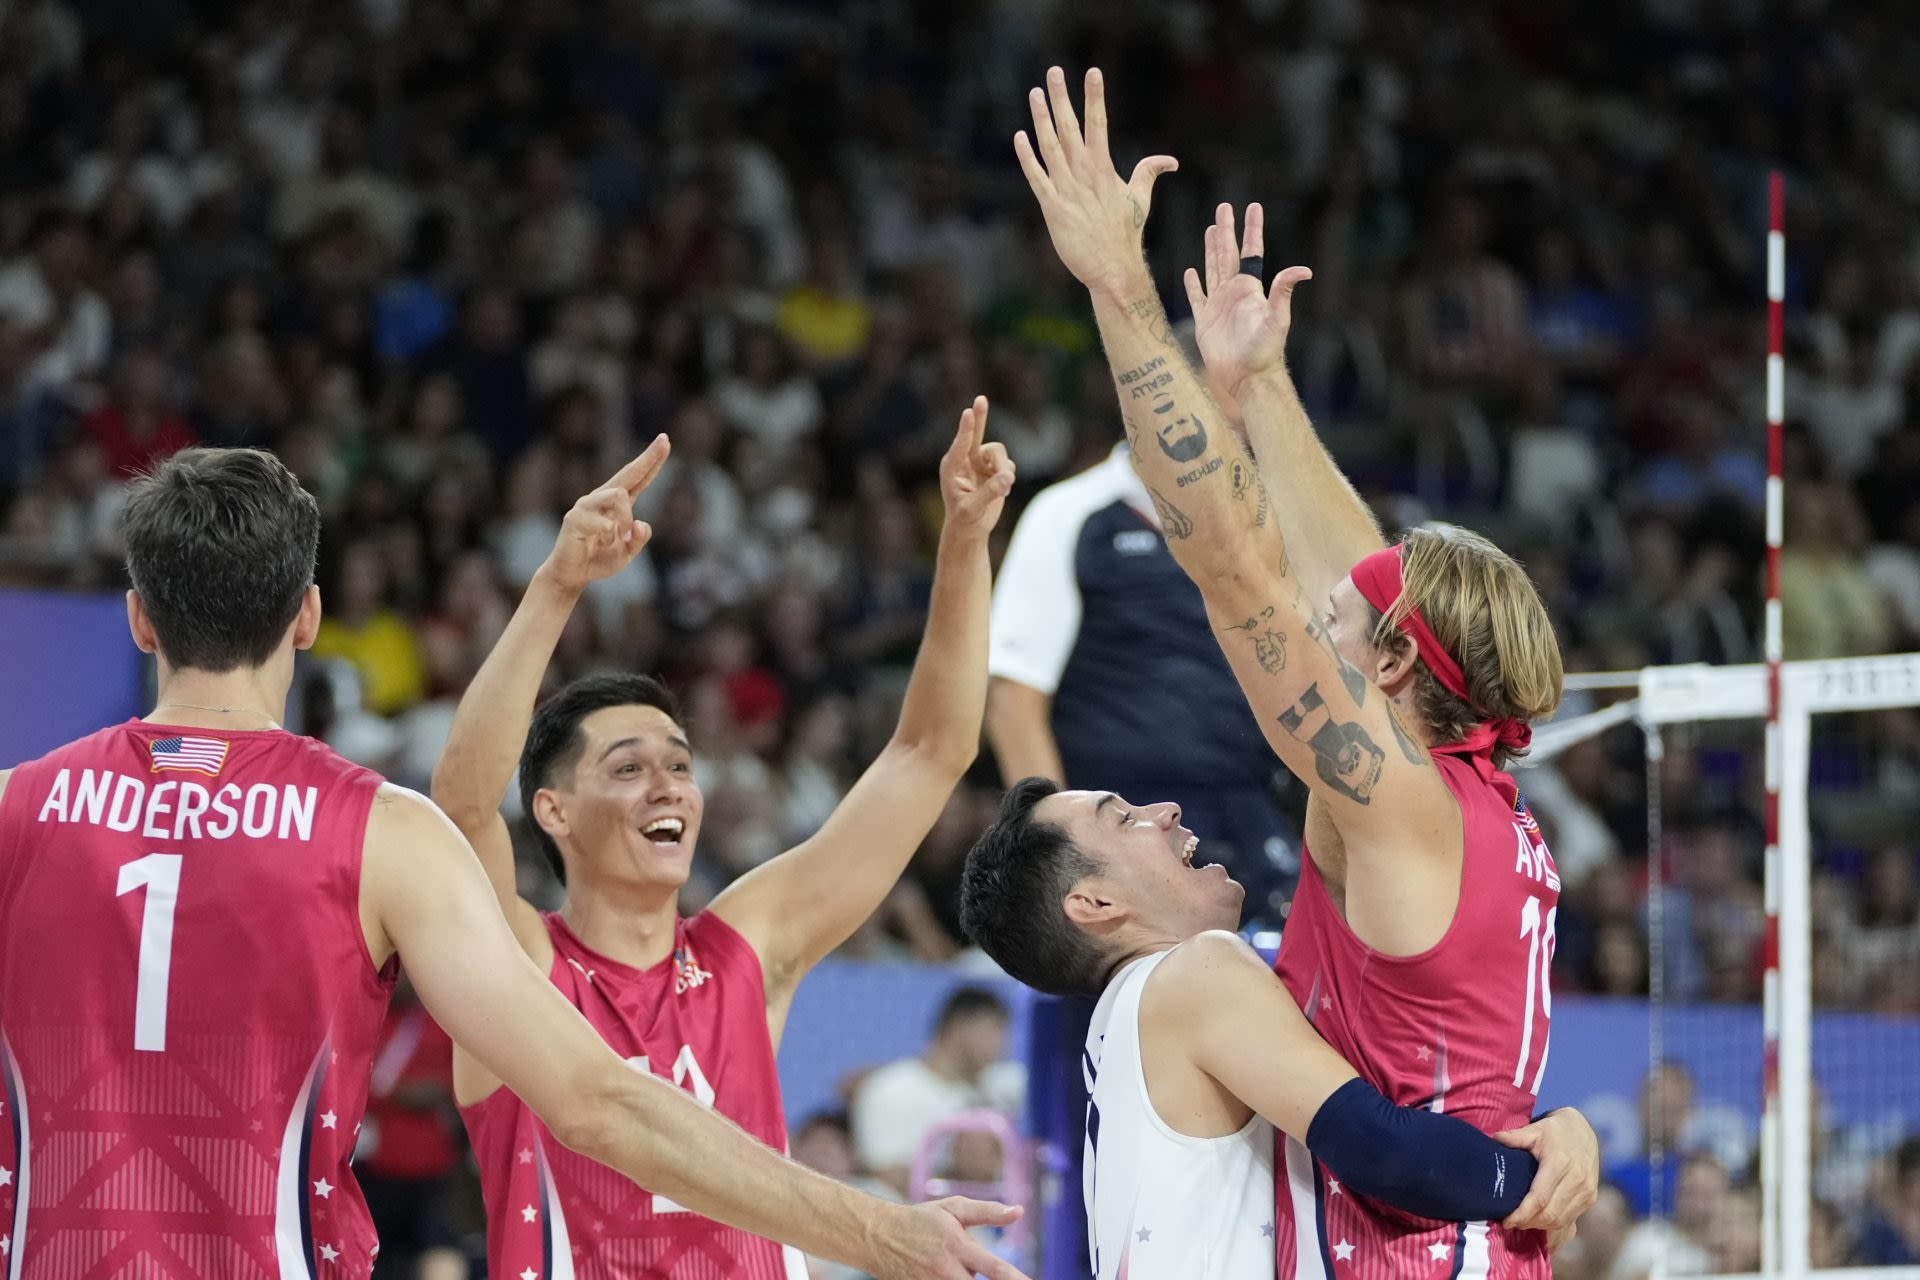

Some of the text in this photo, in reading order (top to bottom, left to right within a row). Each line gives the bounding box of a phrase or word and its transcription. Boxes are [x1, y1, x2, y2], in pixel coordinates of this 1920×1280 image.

[1118, 355, 1167, 386] MATTERS
[1131, 371, 1174, 400] REALLY
[1176, 455, 1224, 488] NOTHING
[38, 768, 318, 841] ANDERSON
[116, 852, 183, 1052] 1
[675, 964, 713, 995] USA
